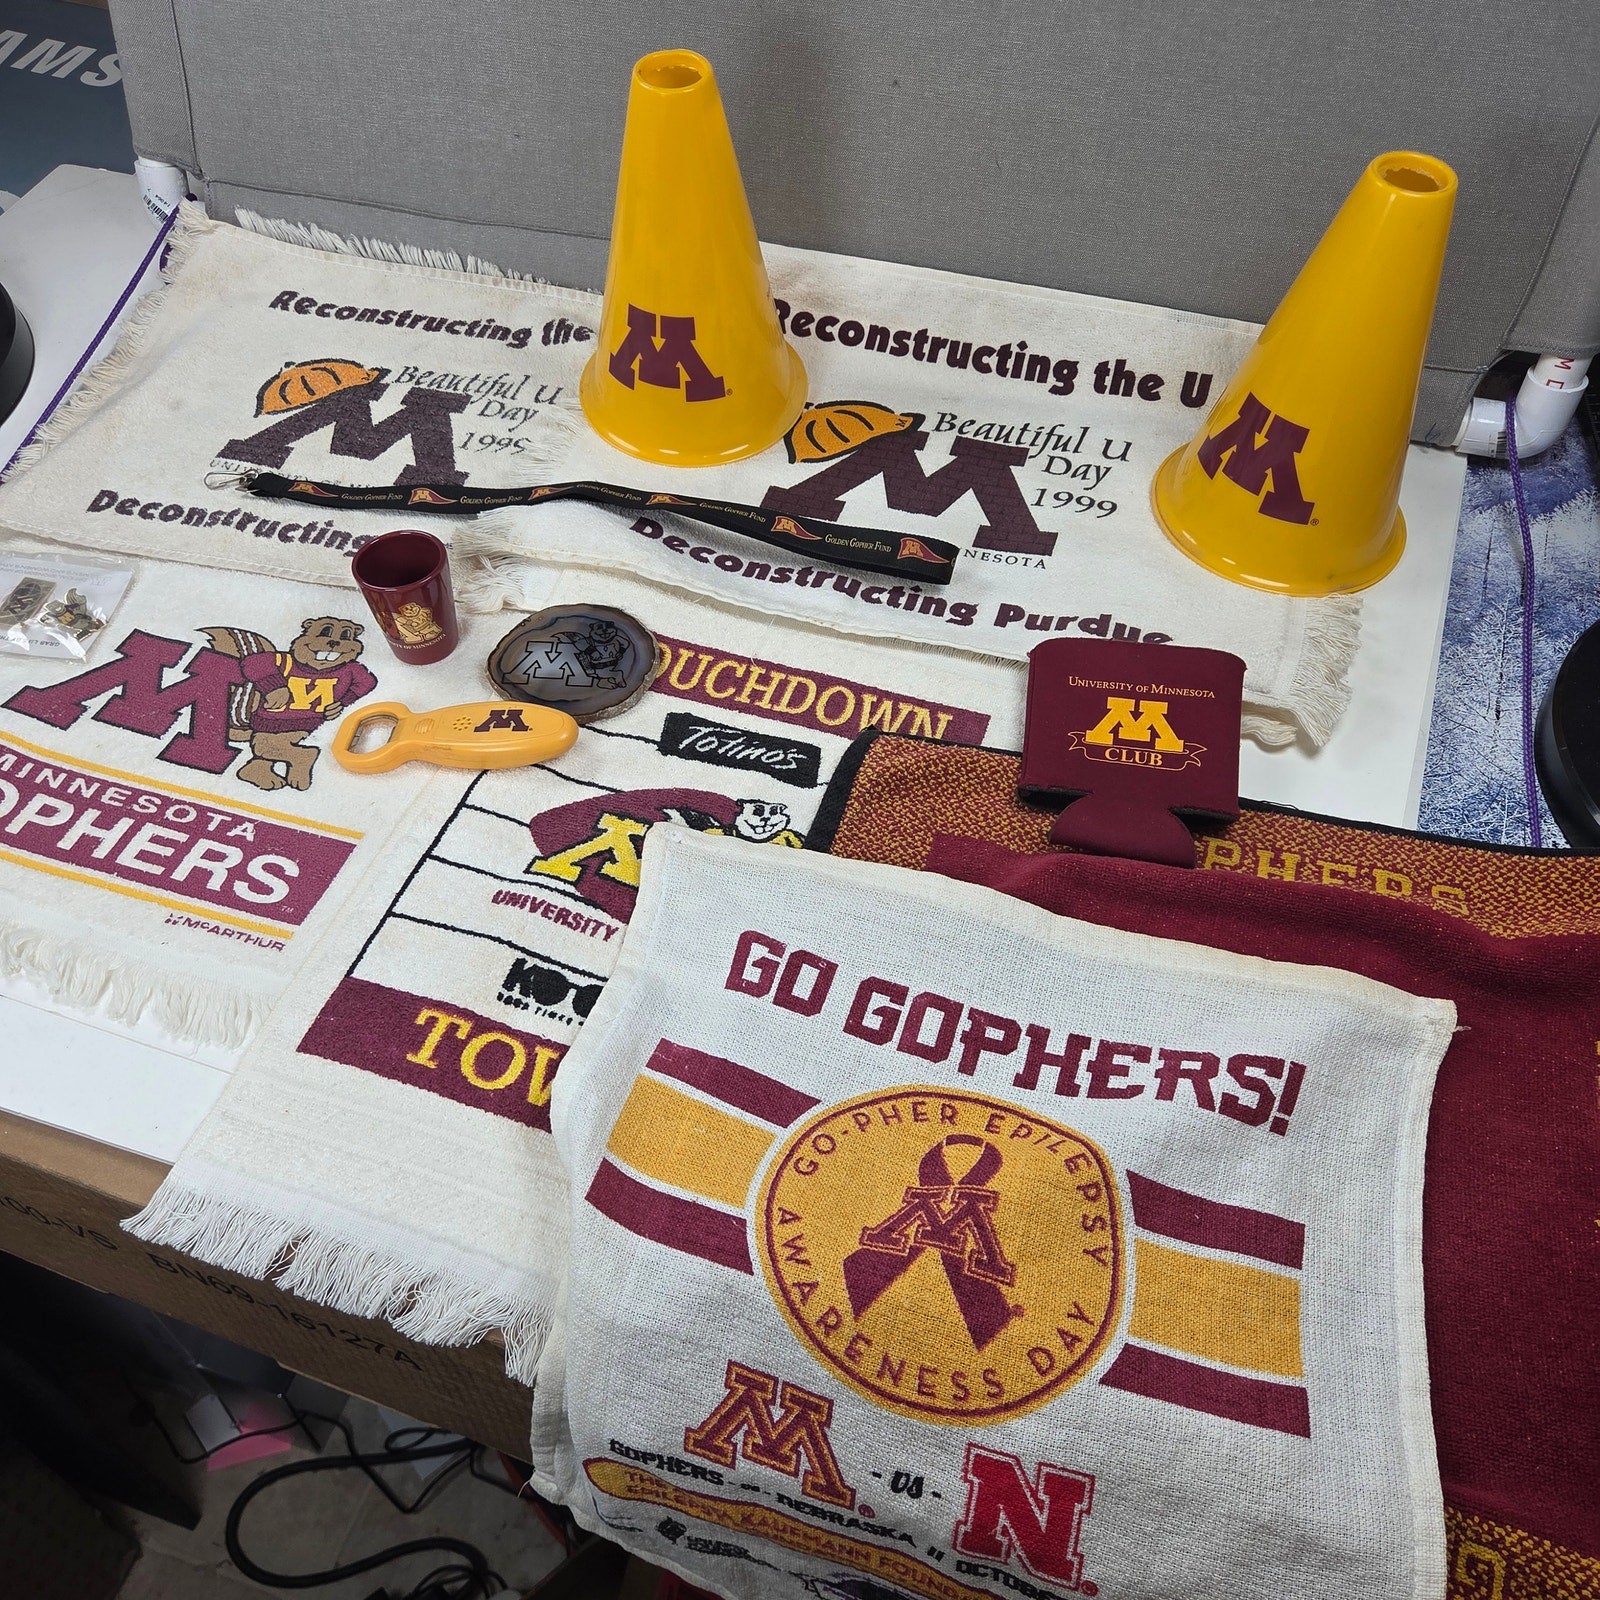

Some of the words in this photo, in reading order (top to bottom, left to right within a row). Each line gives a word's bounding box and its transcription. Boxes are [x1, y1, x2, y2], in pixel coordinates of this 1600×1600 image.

[268, 290, 533, 349] Reconstructing
[541, 318, 595, 346] the
[774, 299, 1080, 396] Reconstructing
[1093, 358, 1165, 401] the
[1180, 370, 1214, 408] U
[394, 366, 531, 405] Beautiful
[477, 398, 540, 433] Day
[931, 411, 1091, 460] Beautiful
[1101, 438, 1133, 462] U
[1041, 455, 1113, 491] Day
[1030, 488, 1118, 519] 1999
[628, 516, 981, 629] Deconstructing
[993, 602, 1173, 643] Purdue
[962, 548, 1047, 570] NESOTA
[1104, 747, 1163, 767] CLUB
[491, 888, 620, 943] UNIVERSITY
[724, 929, 839, 1018] GO
[842, 975, 1308, 1137] GOPHERS!
[792, 1101, 961, 1178] GO-PHER
[983, 1113, 1111, 1269] EPILEPSY
[777, 1206, 1007, 1403] AWARENESS
[1026, 1300, 1098, 1378] DAY
[608, 1438, 725, 1486] GOPHERS
[775, 1491, 917, 1549] NEBRASKA
